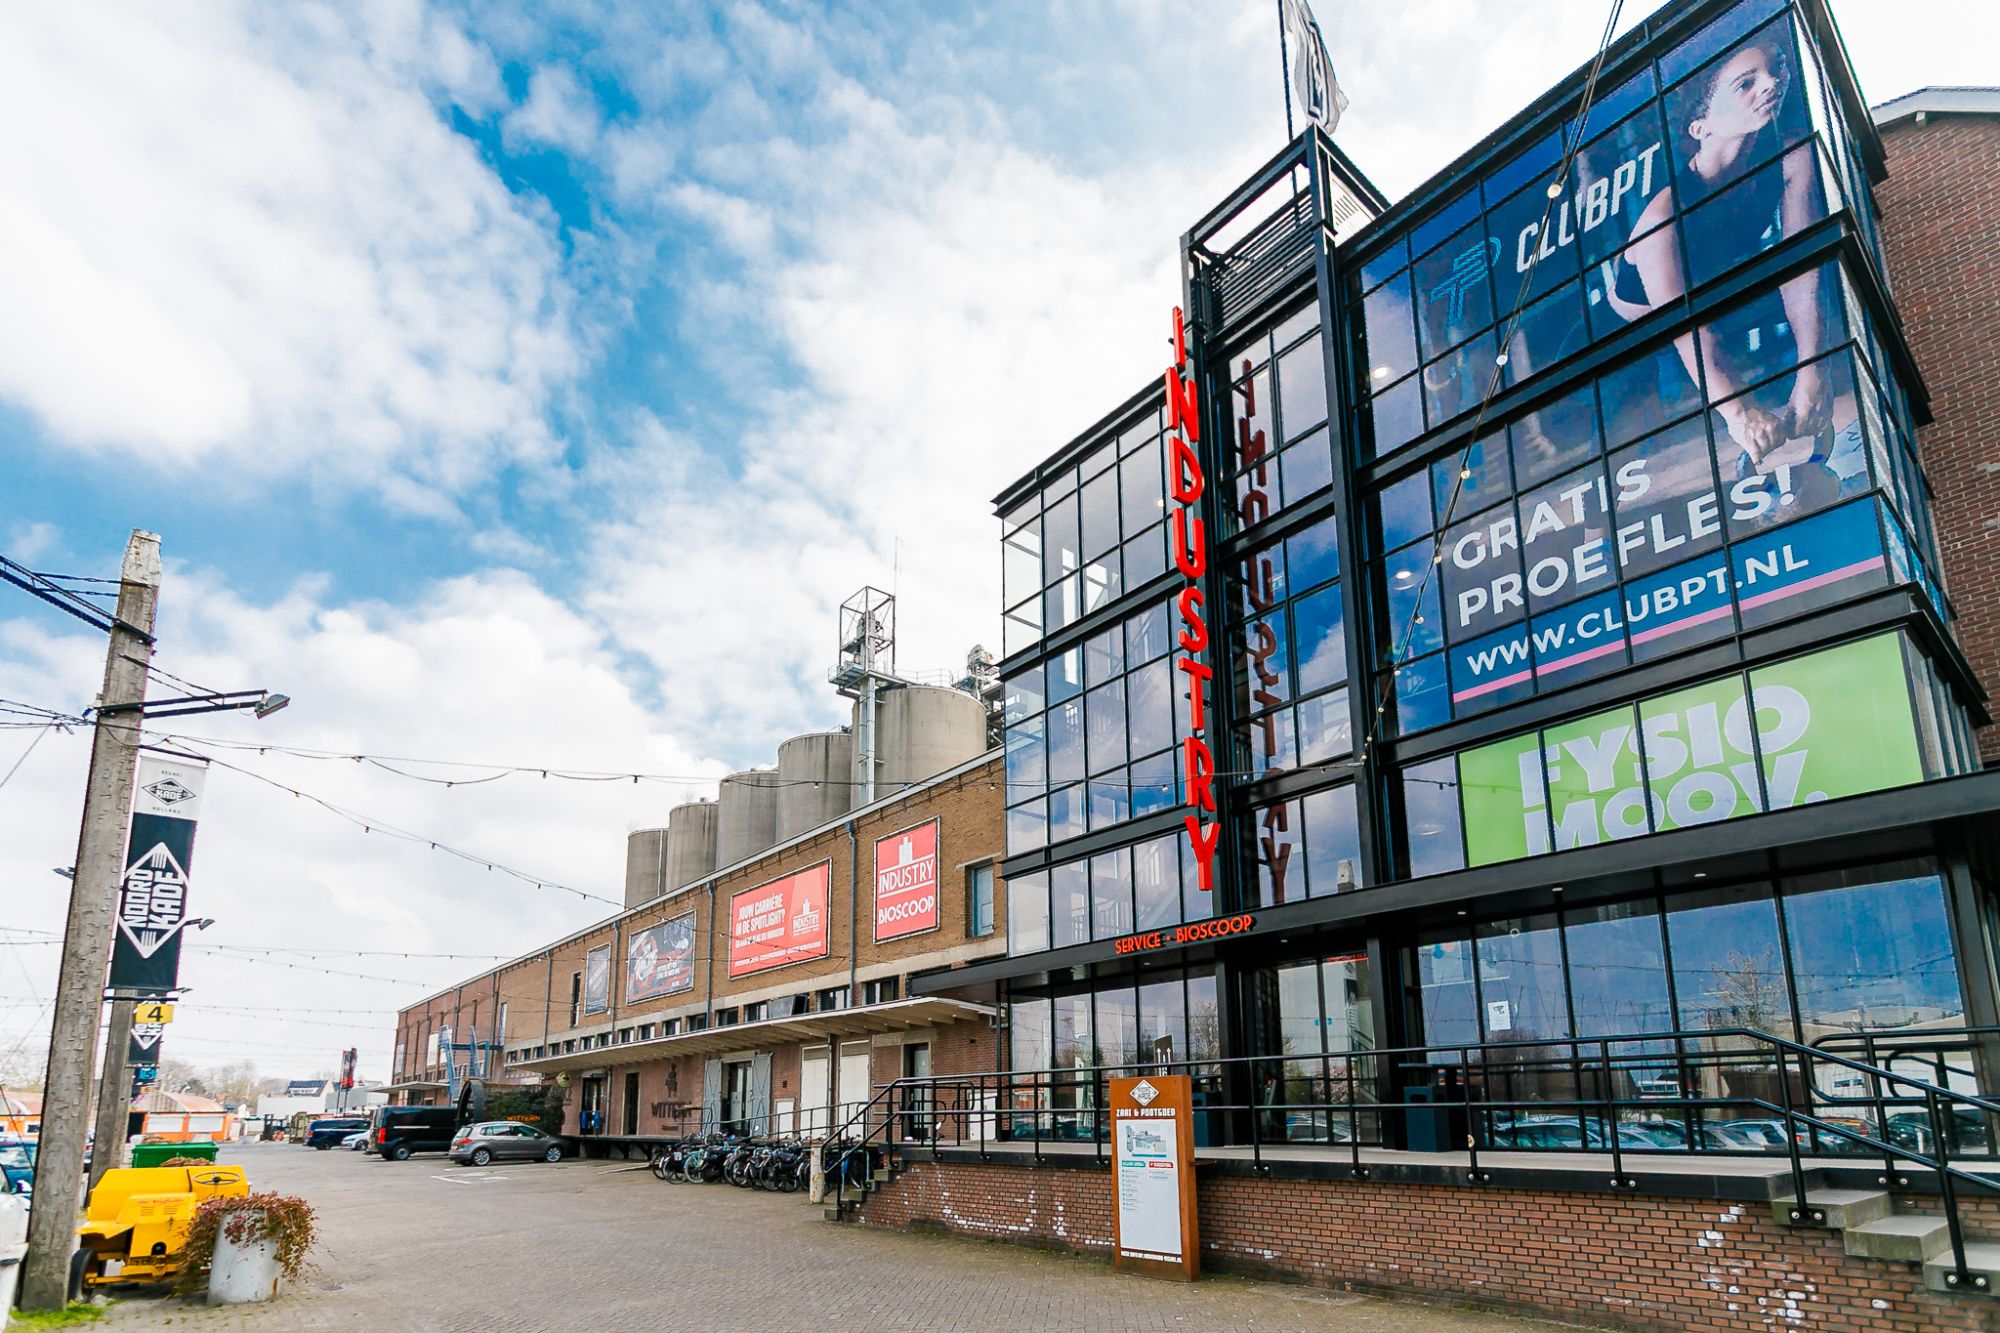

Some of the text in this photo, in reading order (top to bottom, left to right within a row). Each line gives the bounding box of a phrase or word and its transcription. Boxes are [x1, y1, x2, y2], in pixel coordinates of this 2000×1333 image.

[1516, 141, 1661, 273] CLUBPT
[1452, 458, 1652, 570] GRATIS
[1457, 463, 1796, 627] PROEFLES!
[1164, 305, 1221, 892] INDUSTRY
[1466, 543, 1809, 676] WWW.CLUBPT.NL
[1518, 684, 1811, 809] FYSIO
[123, 869, 154, 928] NOORD
[147, 870, 185, 930] KADE
[878, 895, 935, 925] BIOSCOOP
[879, 858, 934, 894] INDUSTRY
[1113, 913, 1253, 955] SERVICE BIOSCOOP
[147, 1006, 163, 1022] 4
